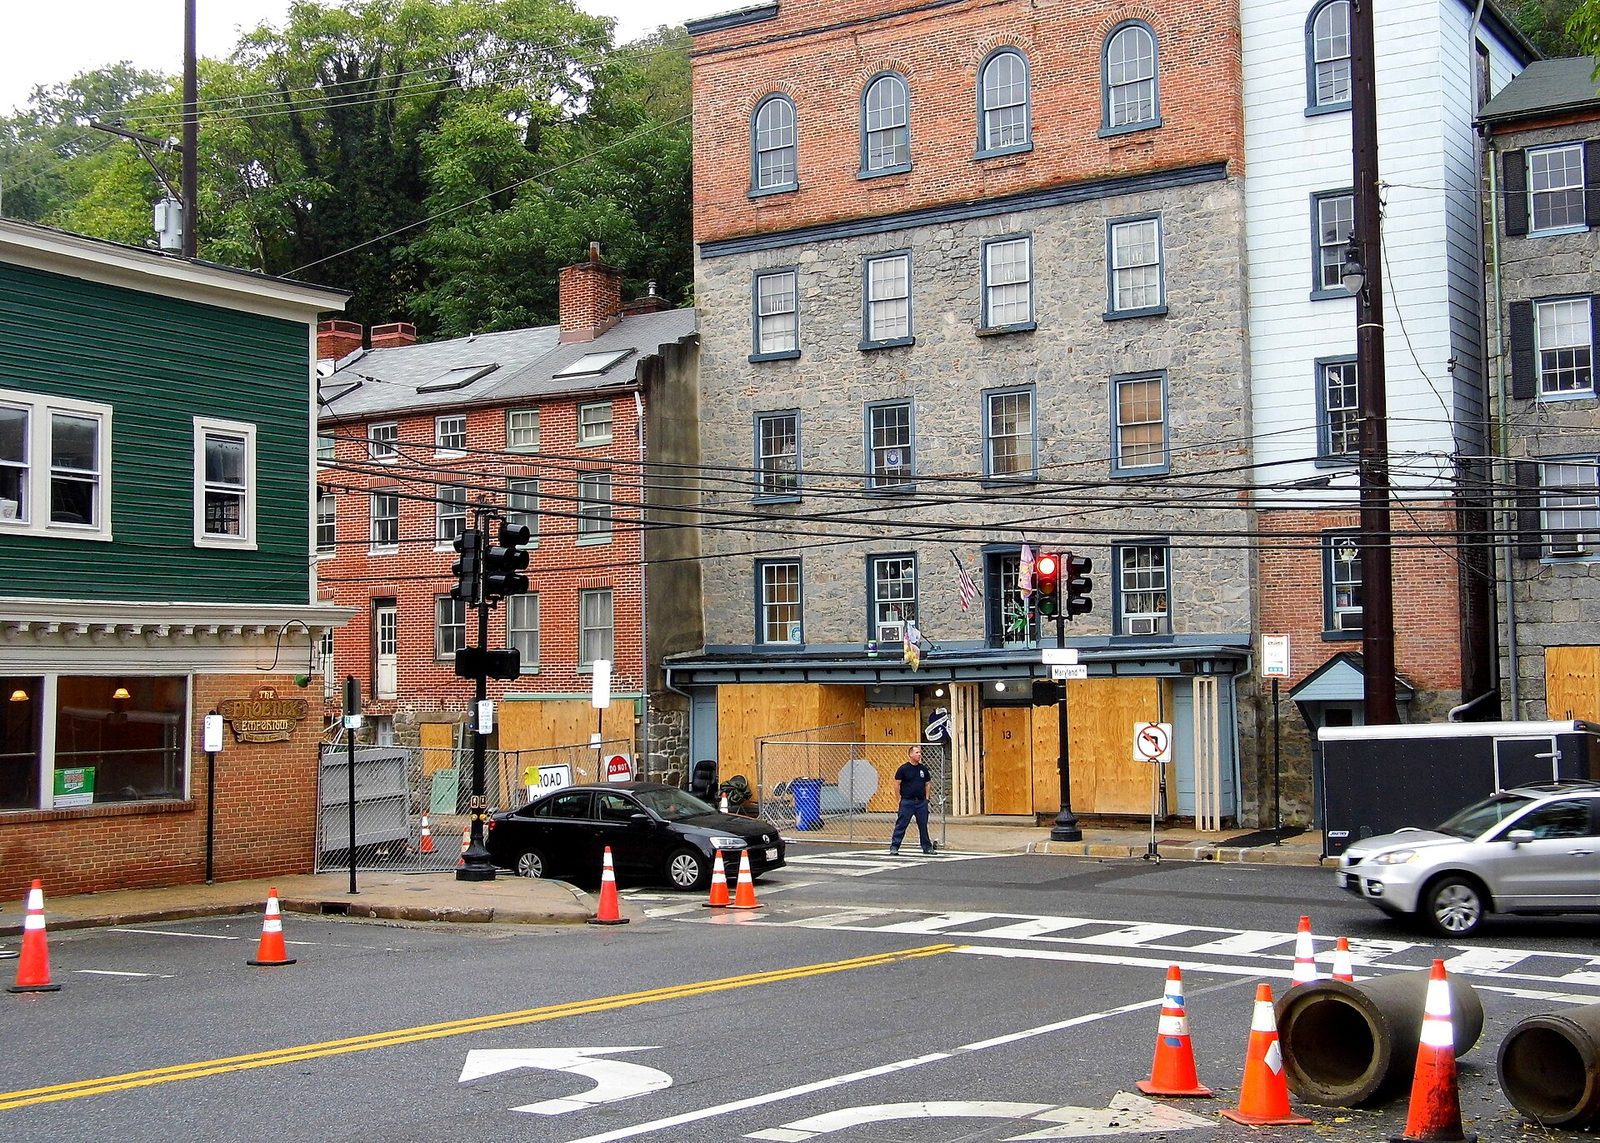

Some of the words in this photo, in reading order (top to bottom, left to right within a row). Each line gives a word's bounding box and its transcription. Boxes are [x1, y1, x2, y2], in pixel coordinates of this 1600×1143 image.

[1054, 667, 1078, 677] Maryland
[232, 700, 298, 719] PHOENIX
[241, 720, 288, 731] EMPORIUM
[884, 727, 894, 737] 14
[1002, 730, 1012, 740] 13
[617, 763, 627, 771] NOT
[537, 772, 562, 788] ROAD
